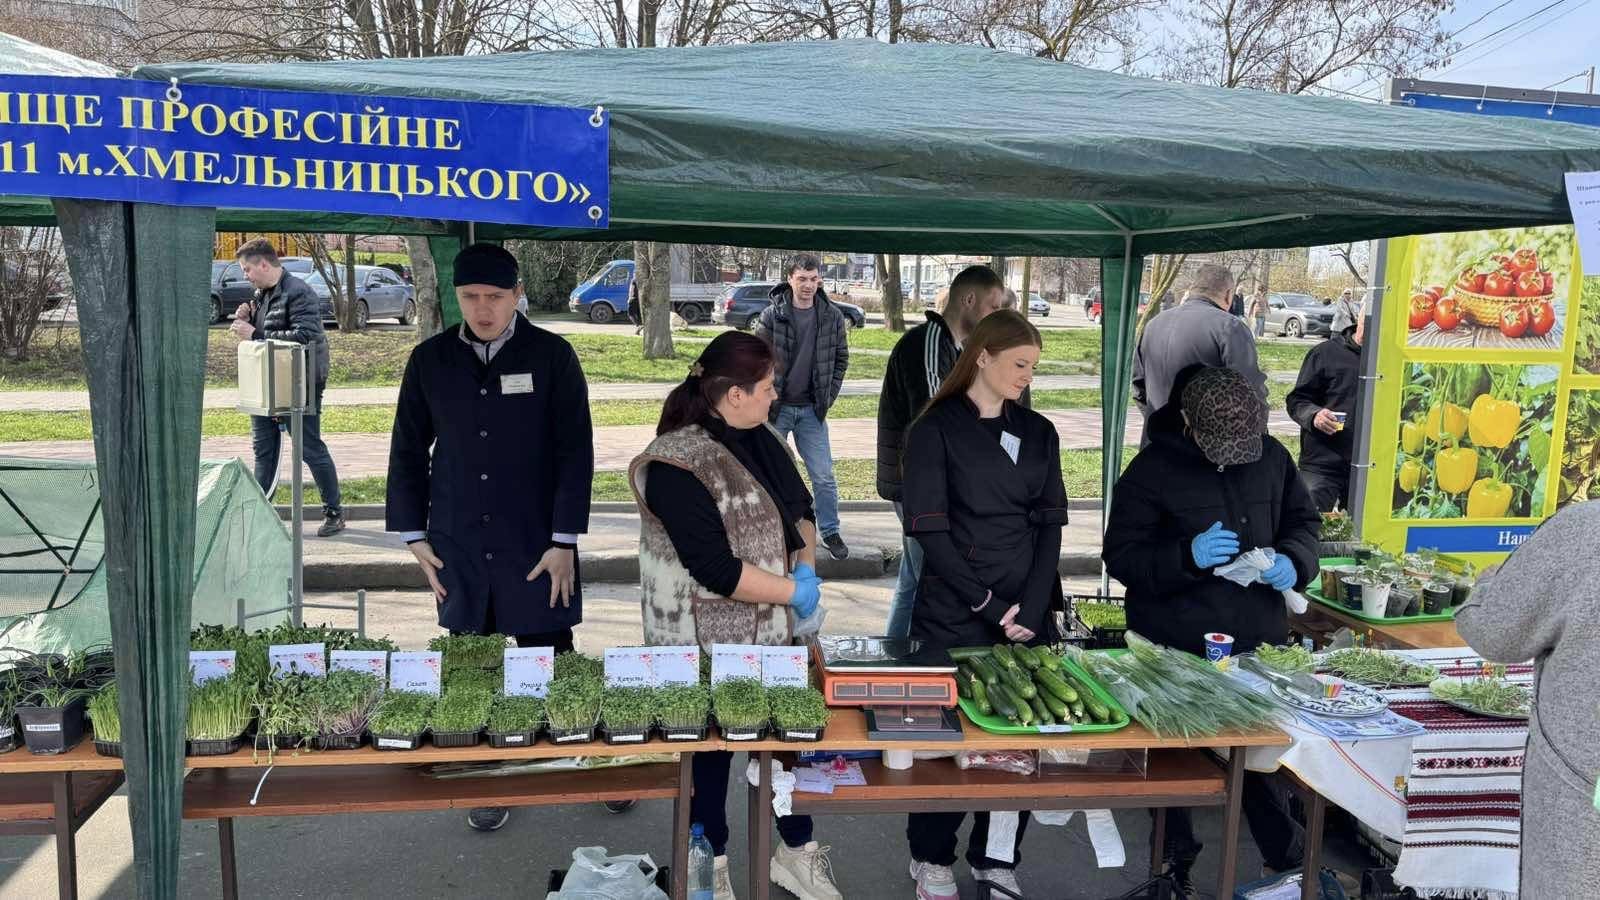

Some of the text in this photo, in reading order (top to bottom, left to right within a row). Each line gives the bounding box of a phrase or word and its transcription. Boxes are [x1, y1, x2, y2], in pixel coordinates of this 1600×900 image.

[118, 96, 462, 150] ПРОФЕСІЙНЕ
[0, 141, 592, 203] 11 м.ХМЕЛЬНИЦЬКОГО»
